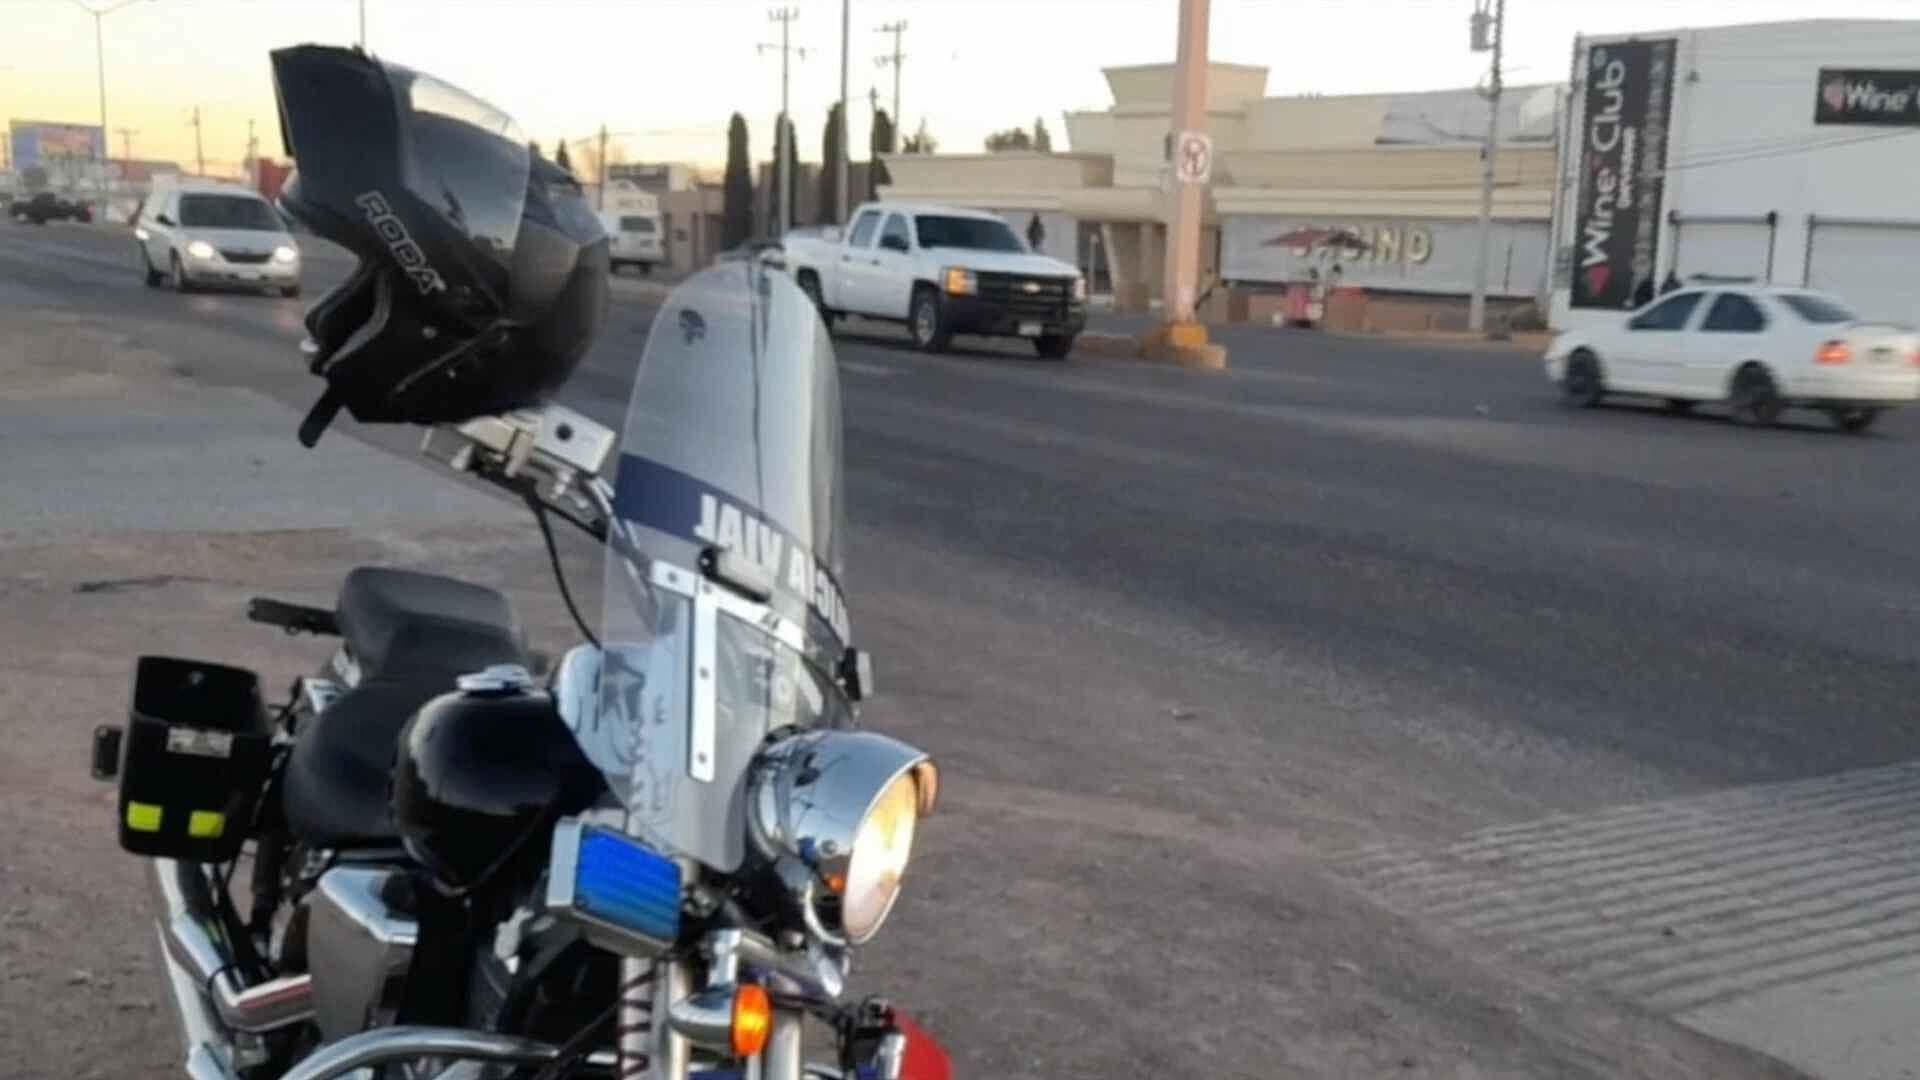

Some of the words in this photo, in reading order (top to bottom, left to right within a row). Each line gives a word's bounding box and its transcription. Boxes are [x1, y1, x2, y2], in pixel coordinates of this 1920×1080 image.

[1592, 60, 1626, 152] Club
[1846, 80, 1908, 112] Wine
[355, 190, 447, 295] RODA
[1582, 167, 1617, 268] Wine
